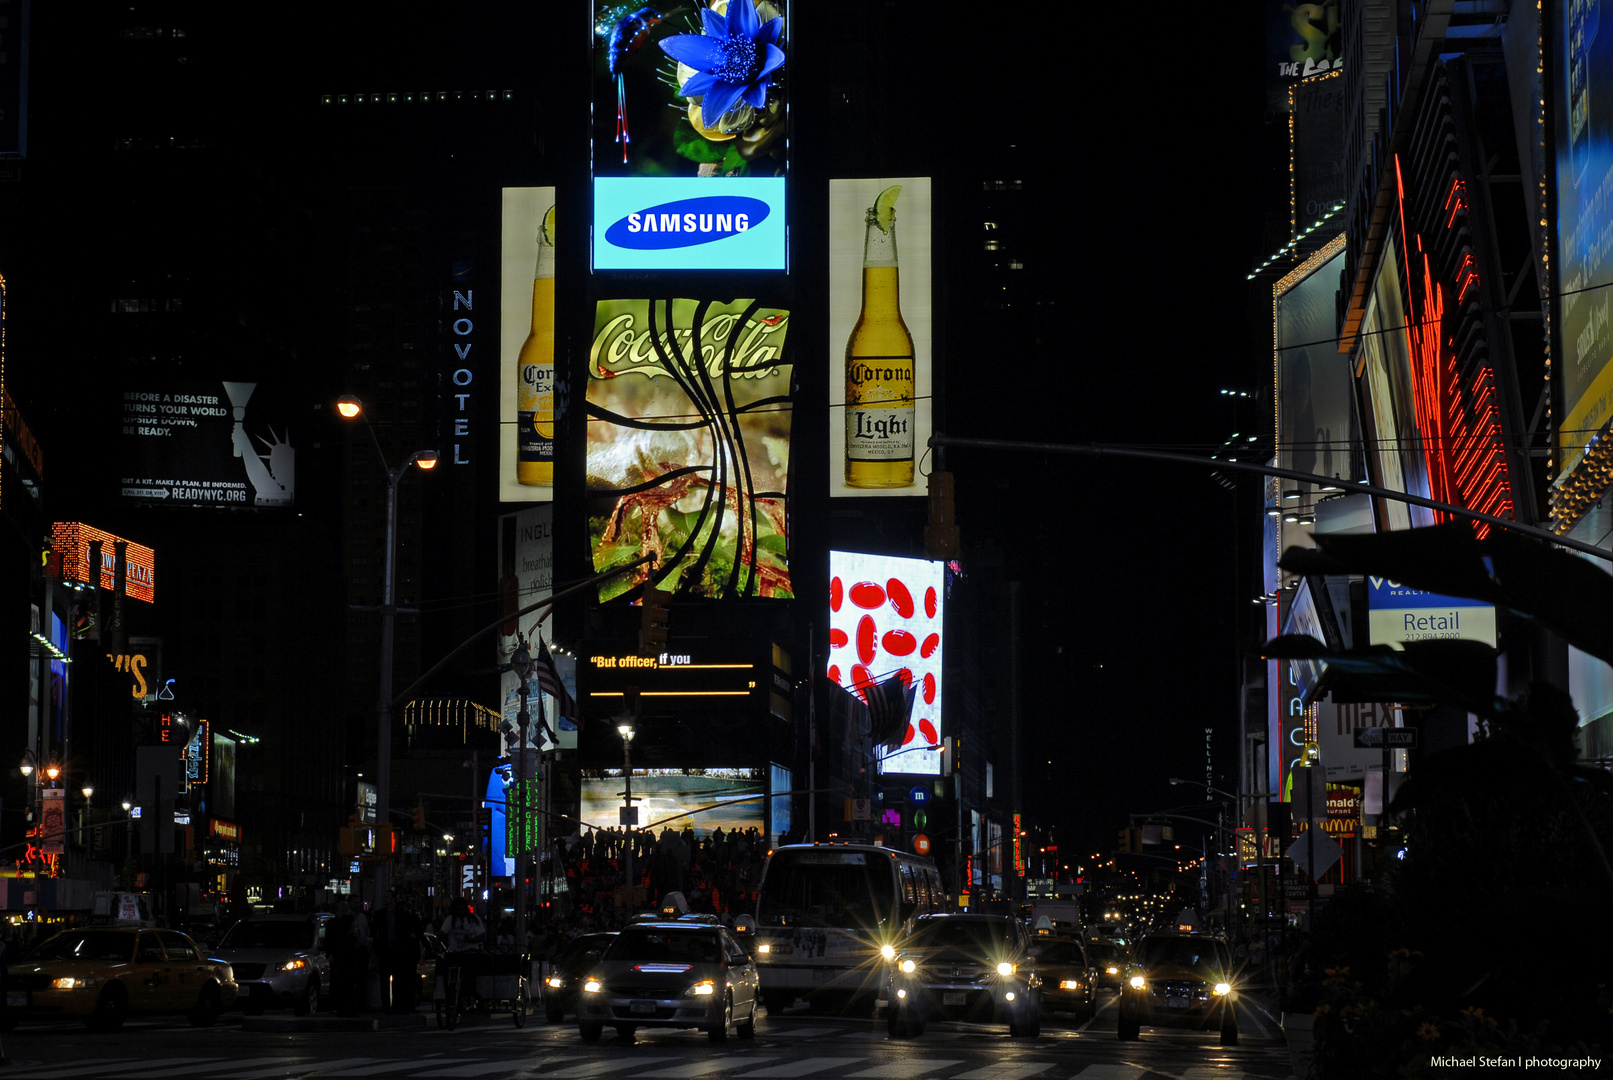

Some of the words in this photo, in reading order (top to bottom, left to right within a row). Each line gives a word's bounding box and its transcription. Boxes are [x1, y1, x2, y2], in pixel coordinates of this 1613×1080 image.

[1278, 62, 1300, 76] THE
[628, 213, 749, 232] SAMSUNG
[453, 290, 473, 465] NOVOTEL
[850, 363, 911, 385] Corona
[123, 392, 160, 402] BEFORE
[163, 394, 171, 402] A
[174, 395, 219, 405] DISASTER
[123, 404, 156, 413] TURNS
[160, 405, 188, 414] YOUR
[190, 406, 228, 416] WORLD
[123, 426, 135, 435] BE
[138, 427, 171, 436] READY.
[855, 412, 907, 439] Light
[211, 481, 247, 489] INFORMED.
[172, 487, 246, 502] READYNYC.ORG
[127, 561, 151, 584] PLAZA
[1404, 611, 1459, 631] Retail
[619, 656, 658, 669] officer,
[670, 654, 691, 666] you
[1363, 734, 1381, 742] ONE
[1390, 734, 1409, 742] WAY
[1205, 728, 1213, 801] WELLINGTON
